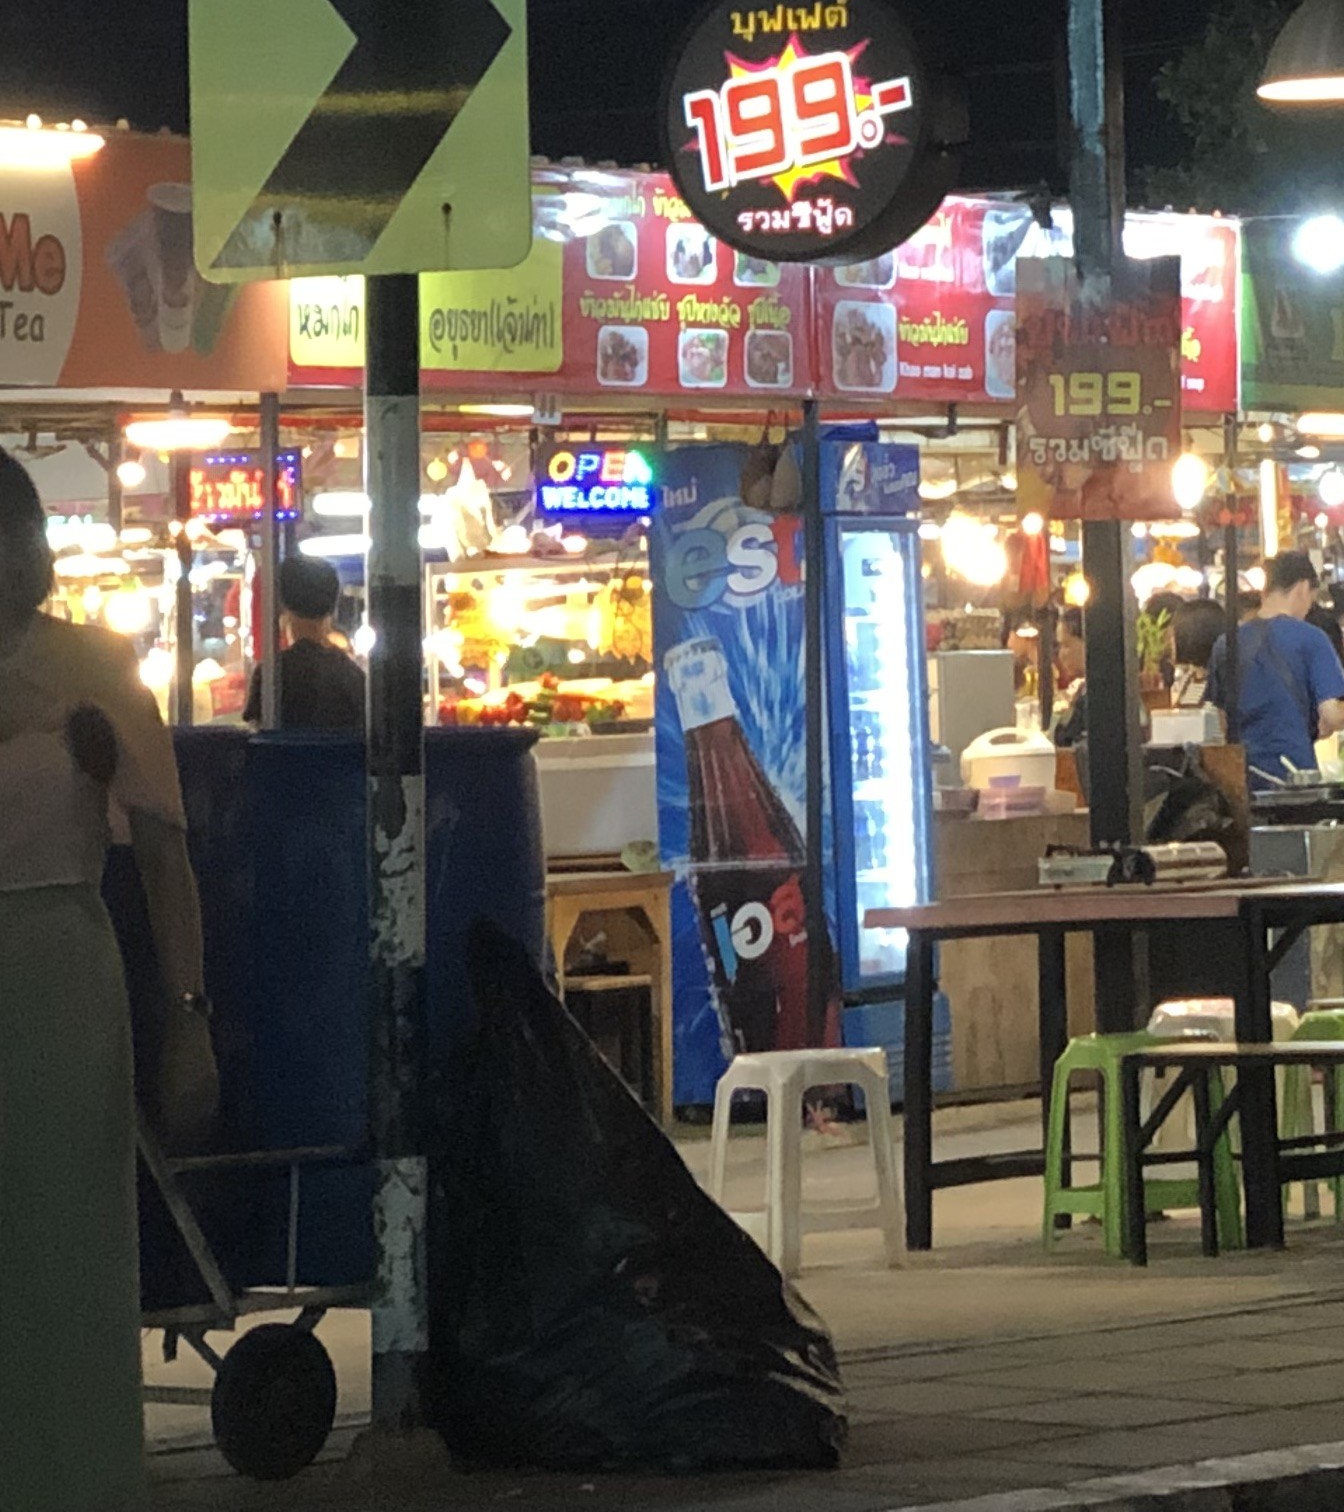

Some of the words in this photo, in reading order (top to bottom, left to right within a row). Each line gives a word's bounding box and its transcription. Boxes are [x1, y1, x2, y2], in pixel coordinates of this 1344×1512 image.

[684, 50, 913, 193] 199.-
[1048, 370, 1173, 418] 199.-
[548, 450, 653, 484] OPEN
[540, 485, 651, 511] WELCOME
